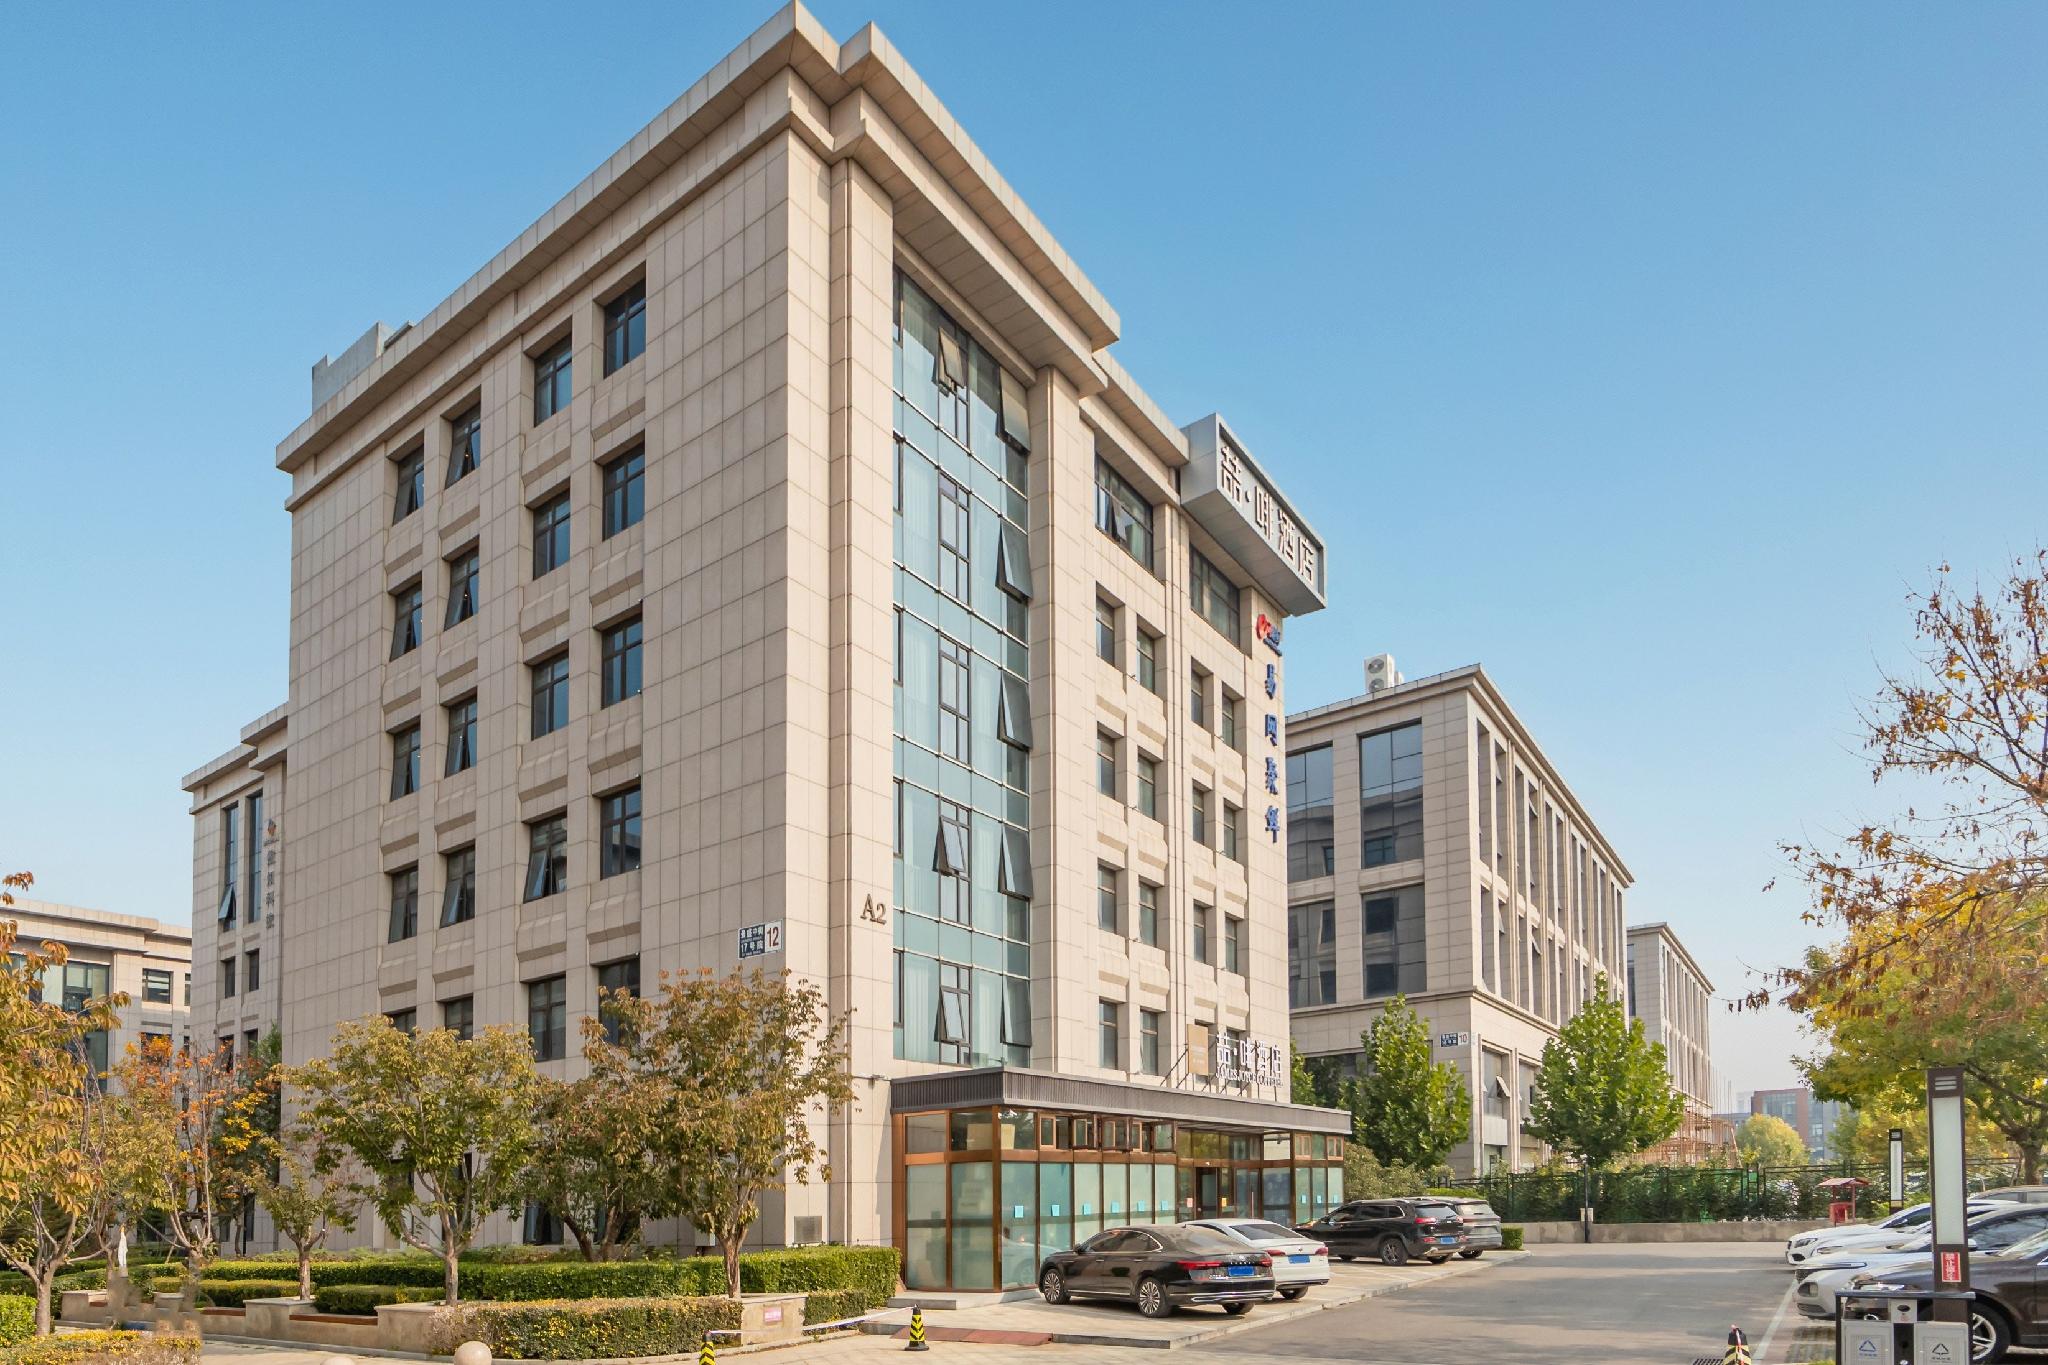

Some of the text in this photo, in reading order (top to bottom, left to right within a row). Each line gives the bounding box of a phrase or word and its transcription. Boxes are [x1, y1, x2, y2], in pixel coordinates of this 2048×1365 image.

[860, 893, 887, 925] A2
[767, 926, 779, 948] 12
[1459, 1033, 1468, 1043] 10
